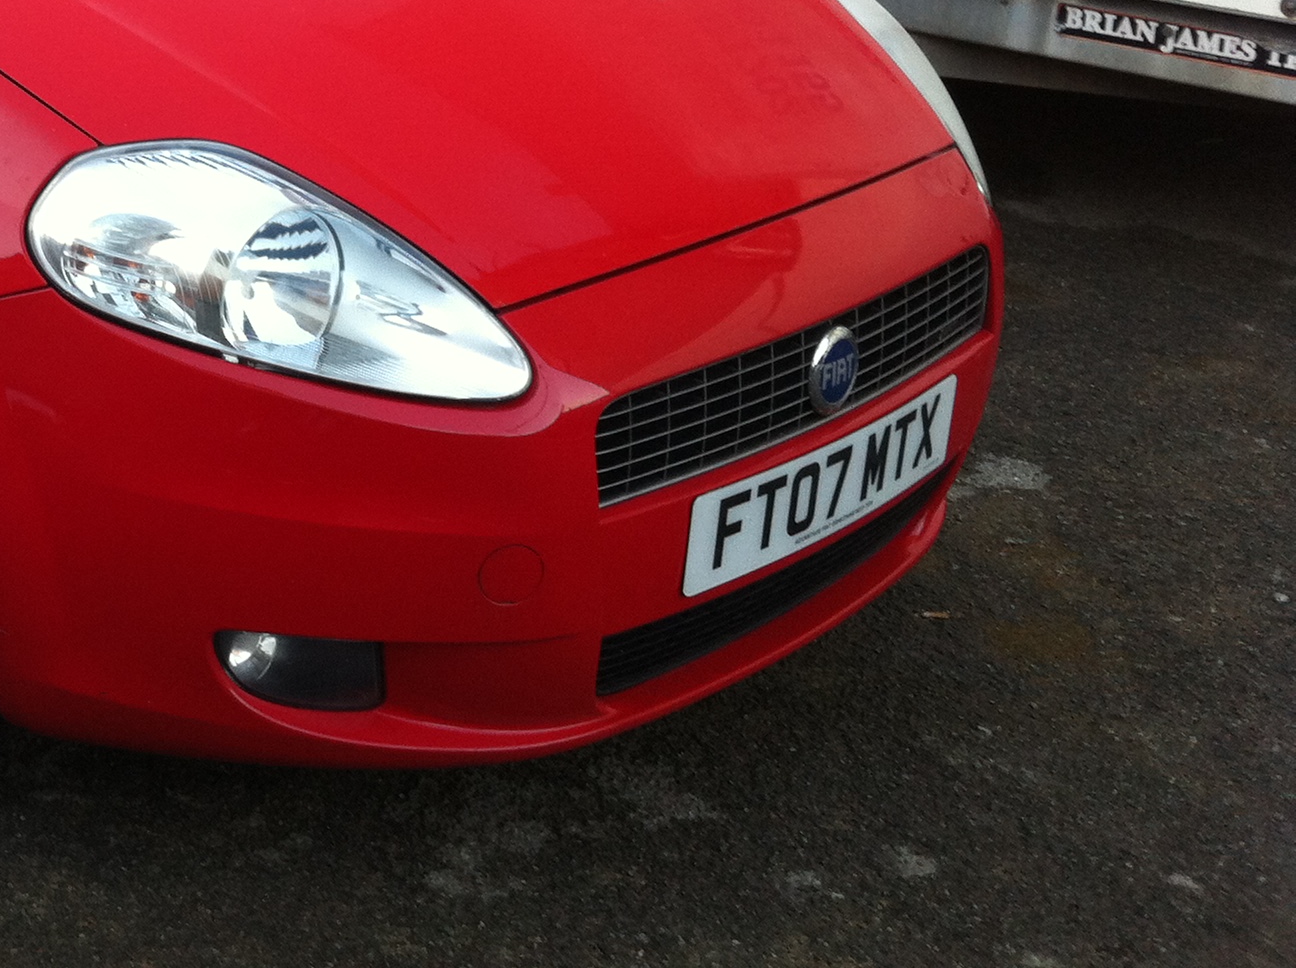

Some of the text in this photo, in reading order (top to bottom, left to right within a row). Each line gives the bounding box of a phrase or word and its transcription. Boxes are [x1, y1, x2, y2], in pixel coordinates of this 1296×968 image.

[1064, 5, 1160, 45] BRIAN
[1159, 24, 1258, 63] JAMES
[822, 352, 854, 390] FIAT
[712, 392, 941, 571] FT07 MTX
